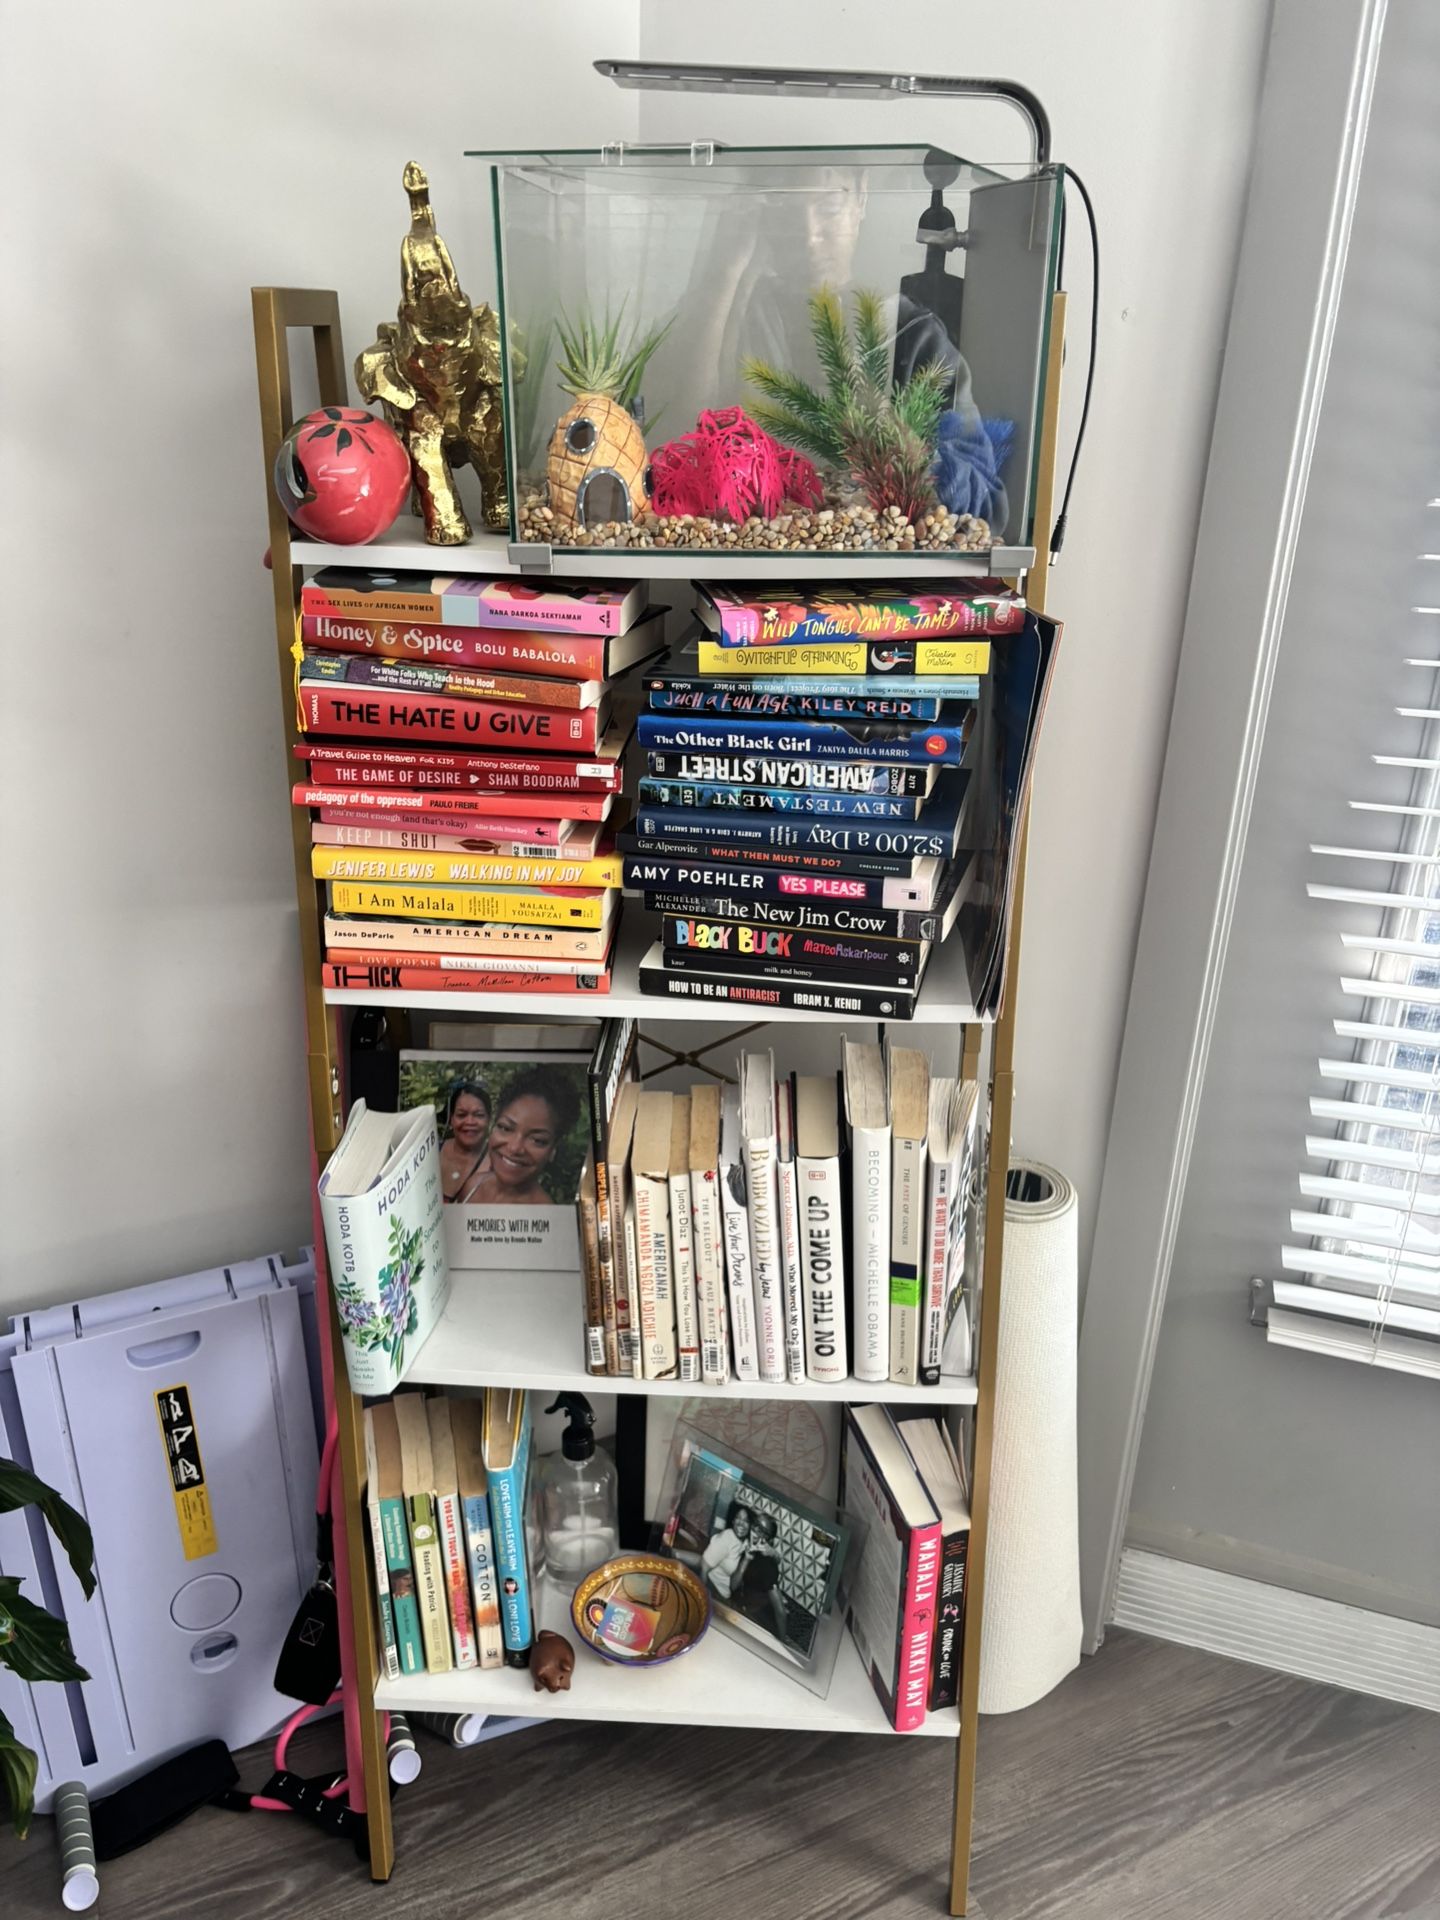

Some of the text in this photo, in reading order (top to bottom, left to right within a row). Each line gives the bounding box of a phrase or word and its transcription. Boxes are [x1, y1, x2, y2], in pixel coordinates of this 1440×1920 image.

[489, 608, 582, 621] NANA DARKOA SEKYIAMAH
[762, 617, 798, 639] WILD
[801, 616, 856, 637] TONGUES
[857, 615, 891, 634] CAN'T
[894, 617, 911, 632] BE
[914, 610, 960, 631] TAMED
[316, 616, 464, 655] Honey & Spice
[475, 642, 506, 656] BOLU
[512, 647, 577, 665] BABALOLA
[736, 648, 798, 666] WITCHFUL
[800, 644, 862, 671] THINKING
[370, 665, 381, 675] For
[382, 666, 400, 677] White
[400, 668, 417, 678] Folks
[417, 669, 433, 680] Who
[434, 671, 454, 683] Teach
[463, 675, 474, 686] the
[476, 678, 496, 689] Hood
[311, 694, 319, 725] THOMAS
[802, 697, 912, 714] KILEY REID
[331, 700, 550, 737] THE HATE U GIVE
[653, 731, 811, 752] The Other Black Girl
[817, 744, 910, 758] ZAKIYA DALILA HARRIS
[336, 768, 461, 785] THE GAME OF DESIRE
[488, 773, 580, 788] SHAN BOODRAM
[678, 755, 874, 792] AMERICAN STREET
[305, 791, 423, 808] pedagogy of the oppressed
[712, 791, 903, 817] NEW TESTAMENT
[336, 827, 438, 849] KEEP IT SHUT
[637, 839, 699, 855] Gar Alperovitz
[806, 824, 851, 850] Day
[856, 832, 871, 847] a
[875, 832, 944, 856] $2.00
[711, 847, 842, 867] WHAT THEN MUST WE DO?
[327, 860, 436, 880] JENIFER LEWIS
[449, 864, 584, 882] WALKING IN MY JOY
[630, 865, 764, 889] AMY POEHLER
[655, 893, 700, 905] MICHELLE
[781, 876, 866, 898] YES PLEASE
[358, 892, 363, 905] I
[370, 893, 395, 908] Am
[402, 895, 455, 912] Malala
[512, 909, 562, 919] YOUSAFZAI
[519, 902, 555, 911] MALALA
[654, 901, 707, 913] ALEXANDER
[714, 897, 887, 932] The New Jim Crow
[333, 930, 395, 940] Jason DeParle
[413, 928, 553, 941] AMERICAN DREAM
[738, 926, 794, 958] BUCK
[359, 955, 436, 967] LOVE POEMS
[668, 980, 781, 1003] HOW TO BE AN ANTIRACIST
[793, 992, 862, 1011] IBRAM X. KENDI
[377, 1130, 437, 1217] HODA KOTB
[867, 1149, 880, 1222] BECOMING
[467, 1218, 550, 1233] MEMORIES WITH MOM
[724, 1211, 741, 1234] Live
[750, 1149, 773, 1300] BAMBOOZLED by Jesus
[934, 1207, 948, 1228] WANT
[338, 1206, 356, 1274] HODA KOTB
[702, 1197, 713, 1263] THE SELLOUT
[934, 1228, 946, 1238] TO
[636, 1189, 657, 1339] CHIMAMANDA NGOZI ADICHIE
[653, 1232, 668, 1301] AMERICANAH
[932, 1247, 946, 1265] MORE
[731, 1252, 746, 1289] Dreams
[807, 1194, 836, 1357] ON THE COME UP
[931, 1266, 945, 1283] THAN
[706, 1280, 714, 1304] PAUL
[866, 1242, 880, 1360] MICHELLE OBAMA
[929, 1283, 944, 1308] SURVIVE
[764, 1304, 775, 1369] YVONNE ORJI
[423, 1550, 432, 1576] Reading
[475, 1543, 491, 1602] COTTON
[914, 1537, 938, 1604] WAHALA
[952, 1562, 965, 1594] JASMINE
[427, 1589, 437, 1613] Patrick
[507, 1599, 522, 1643] LONI LOVE
[905, 1630, 929, 1709] NIKKI MAY
